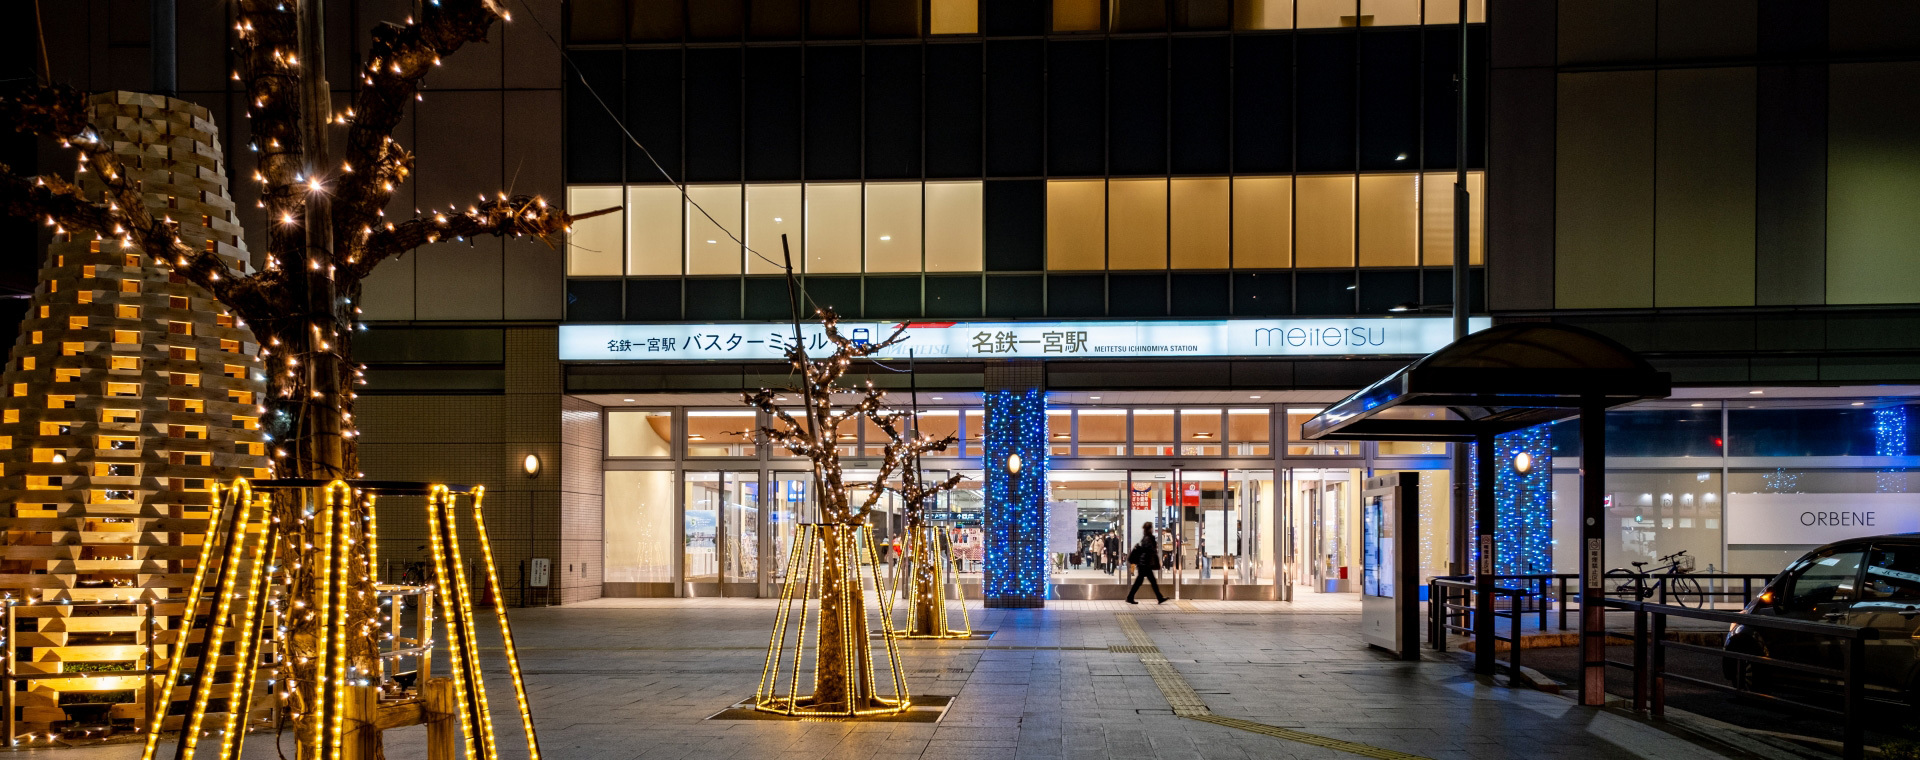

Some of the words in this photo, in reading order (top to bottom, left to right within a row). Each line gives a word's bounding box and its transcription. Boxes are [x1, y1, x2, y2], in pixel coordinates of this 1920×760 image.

[971, 330, 1088, 353] 名鉄一宮駅
[1255, 326, 1385, 347] meitetsu
[607, 337, 676, 352] 名鉄一宮駅
[1094, 345, 1127, 353] MEITETSU
[1800, 511, 1876, 526] ORBENE
